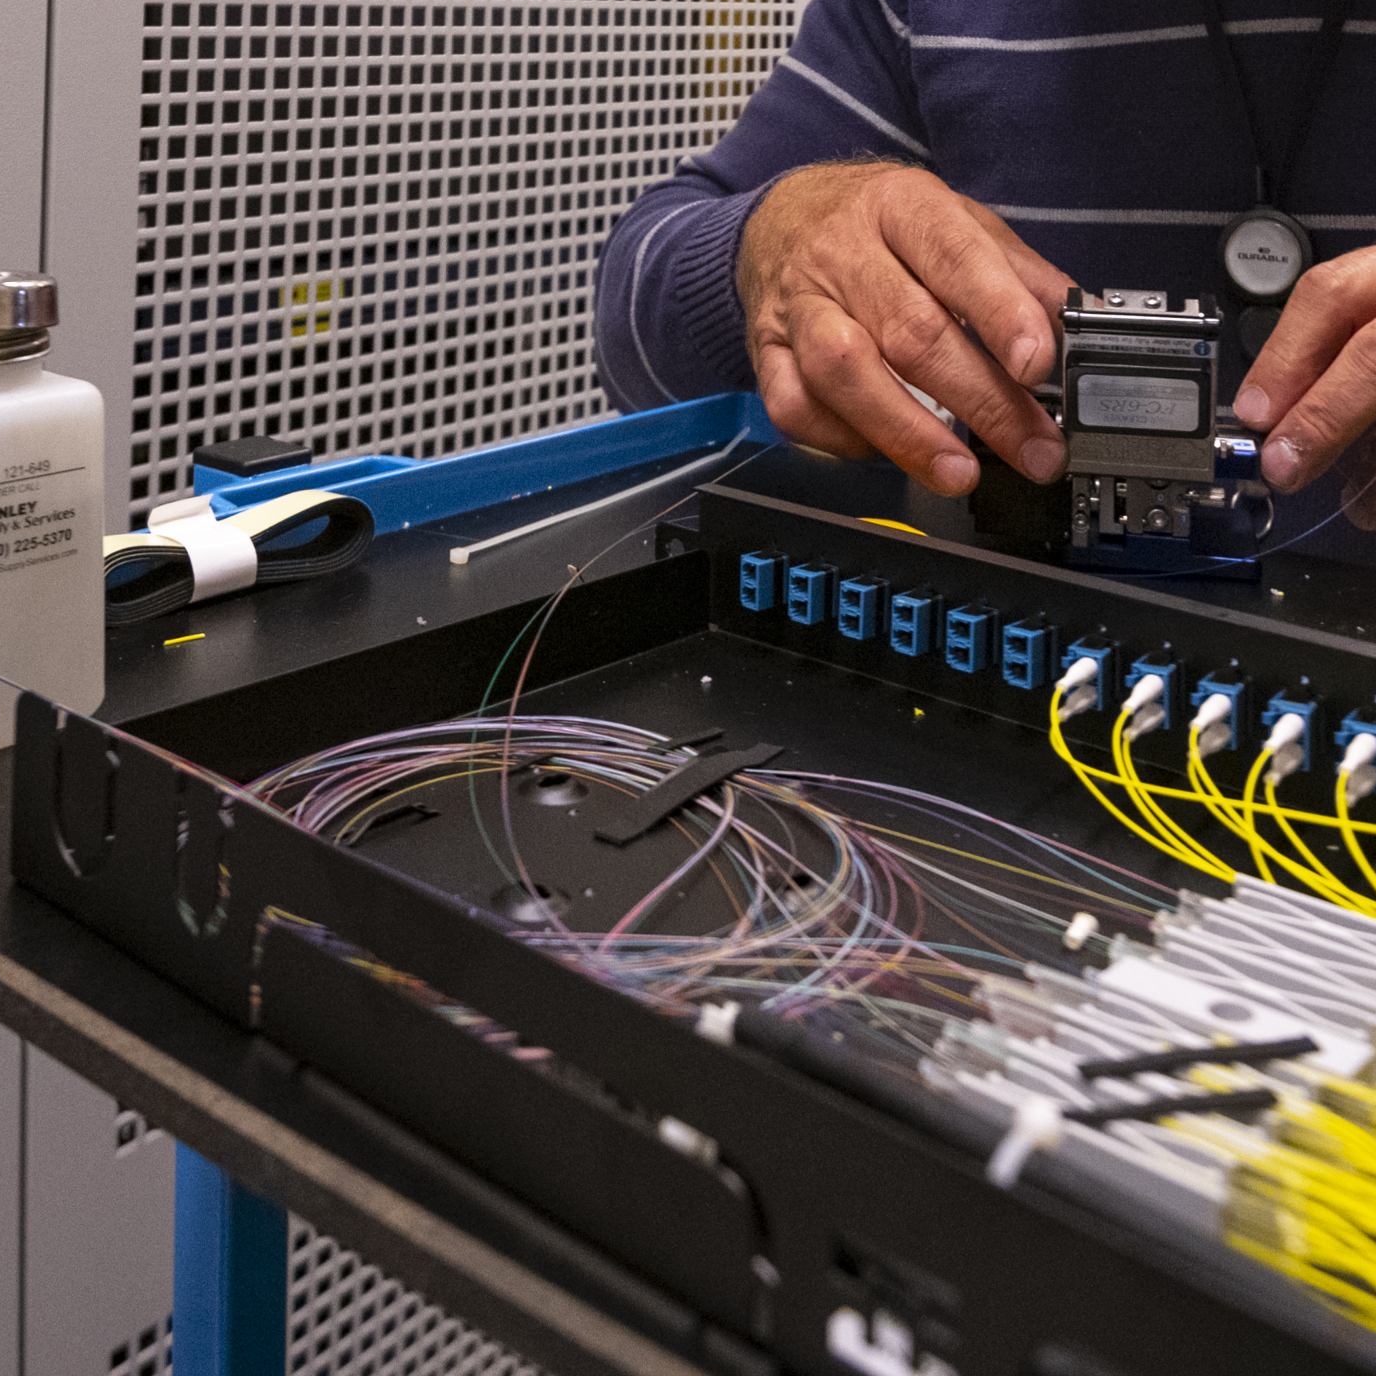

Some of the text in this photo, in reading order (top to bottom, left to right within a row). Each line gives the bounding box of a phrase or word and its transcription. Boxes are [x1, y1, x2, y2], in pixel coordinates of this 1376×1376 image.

[1238, 251, 1290, 264] DURABLE
[4, 459, 51, 478] 121-649
[12, 520, 21, 531] &
[24, 509, 76, 528] Services
[13, 528, 73, 553] 225-5370
